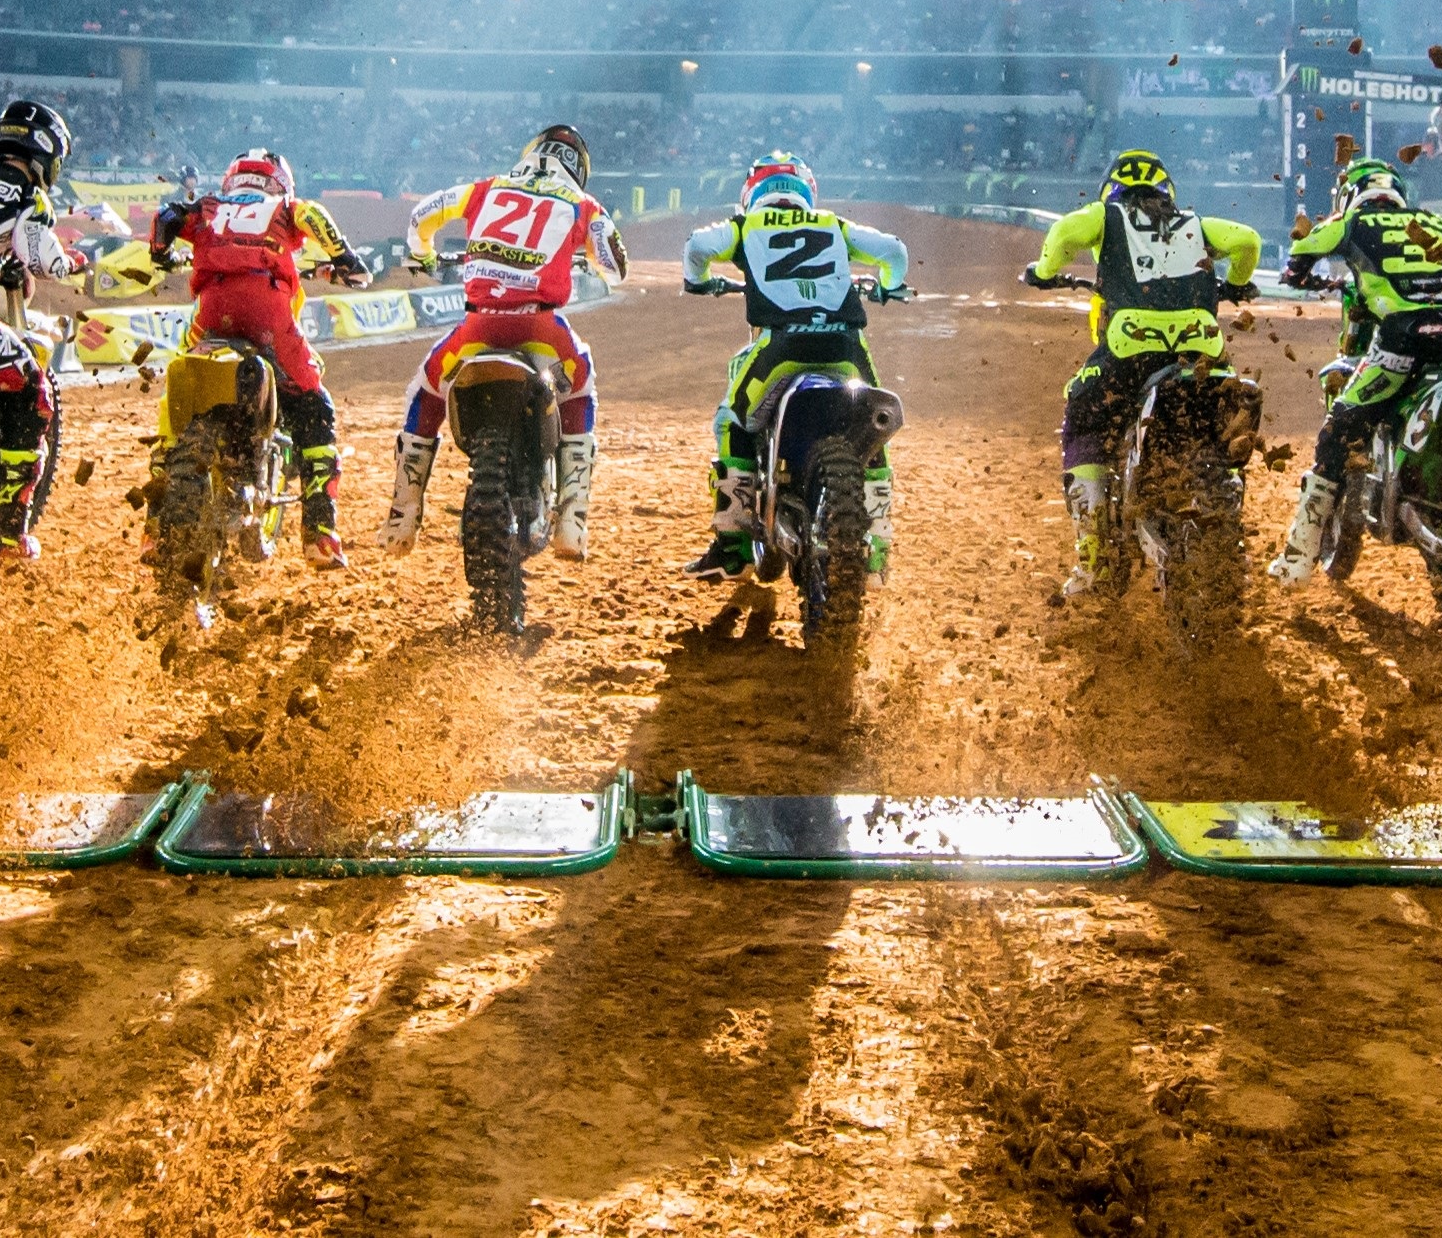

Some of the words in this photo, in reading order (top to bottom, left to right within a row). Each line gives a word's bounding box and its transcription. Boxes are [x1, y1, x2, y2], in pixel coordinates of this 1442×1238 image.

[1320, 77, 1442, 103] HOLESHOT
[1296, 113, 1306, 129] 2
[1297, 144, 1307, 160] 3
[1117, 160, 1159, 182] 47
[480, 191, 557, 251] 21
[765, 228, 836, 282] 2
[475, 267, 538, 285] Husqvarna
[786, 323, 848, 334] THOR
